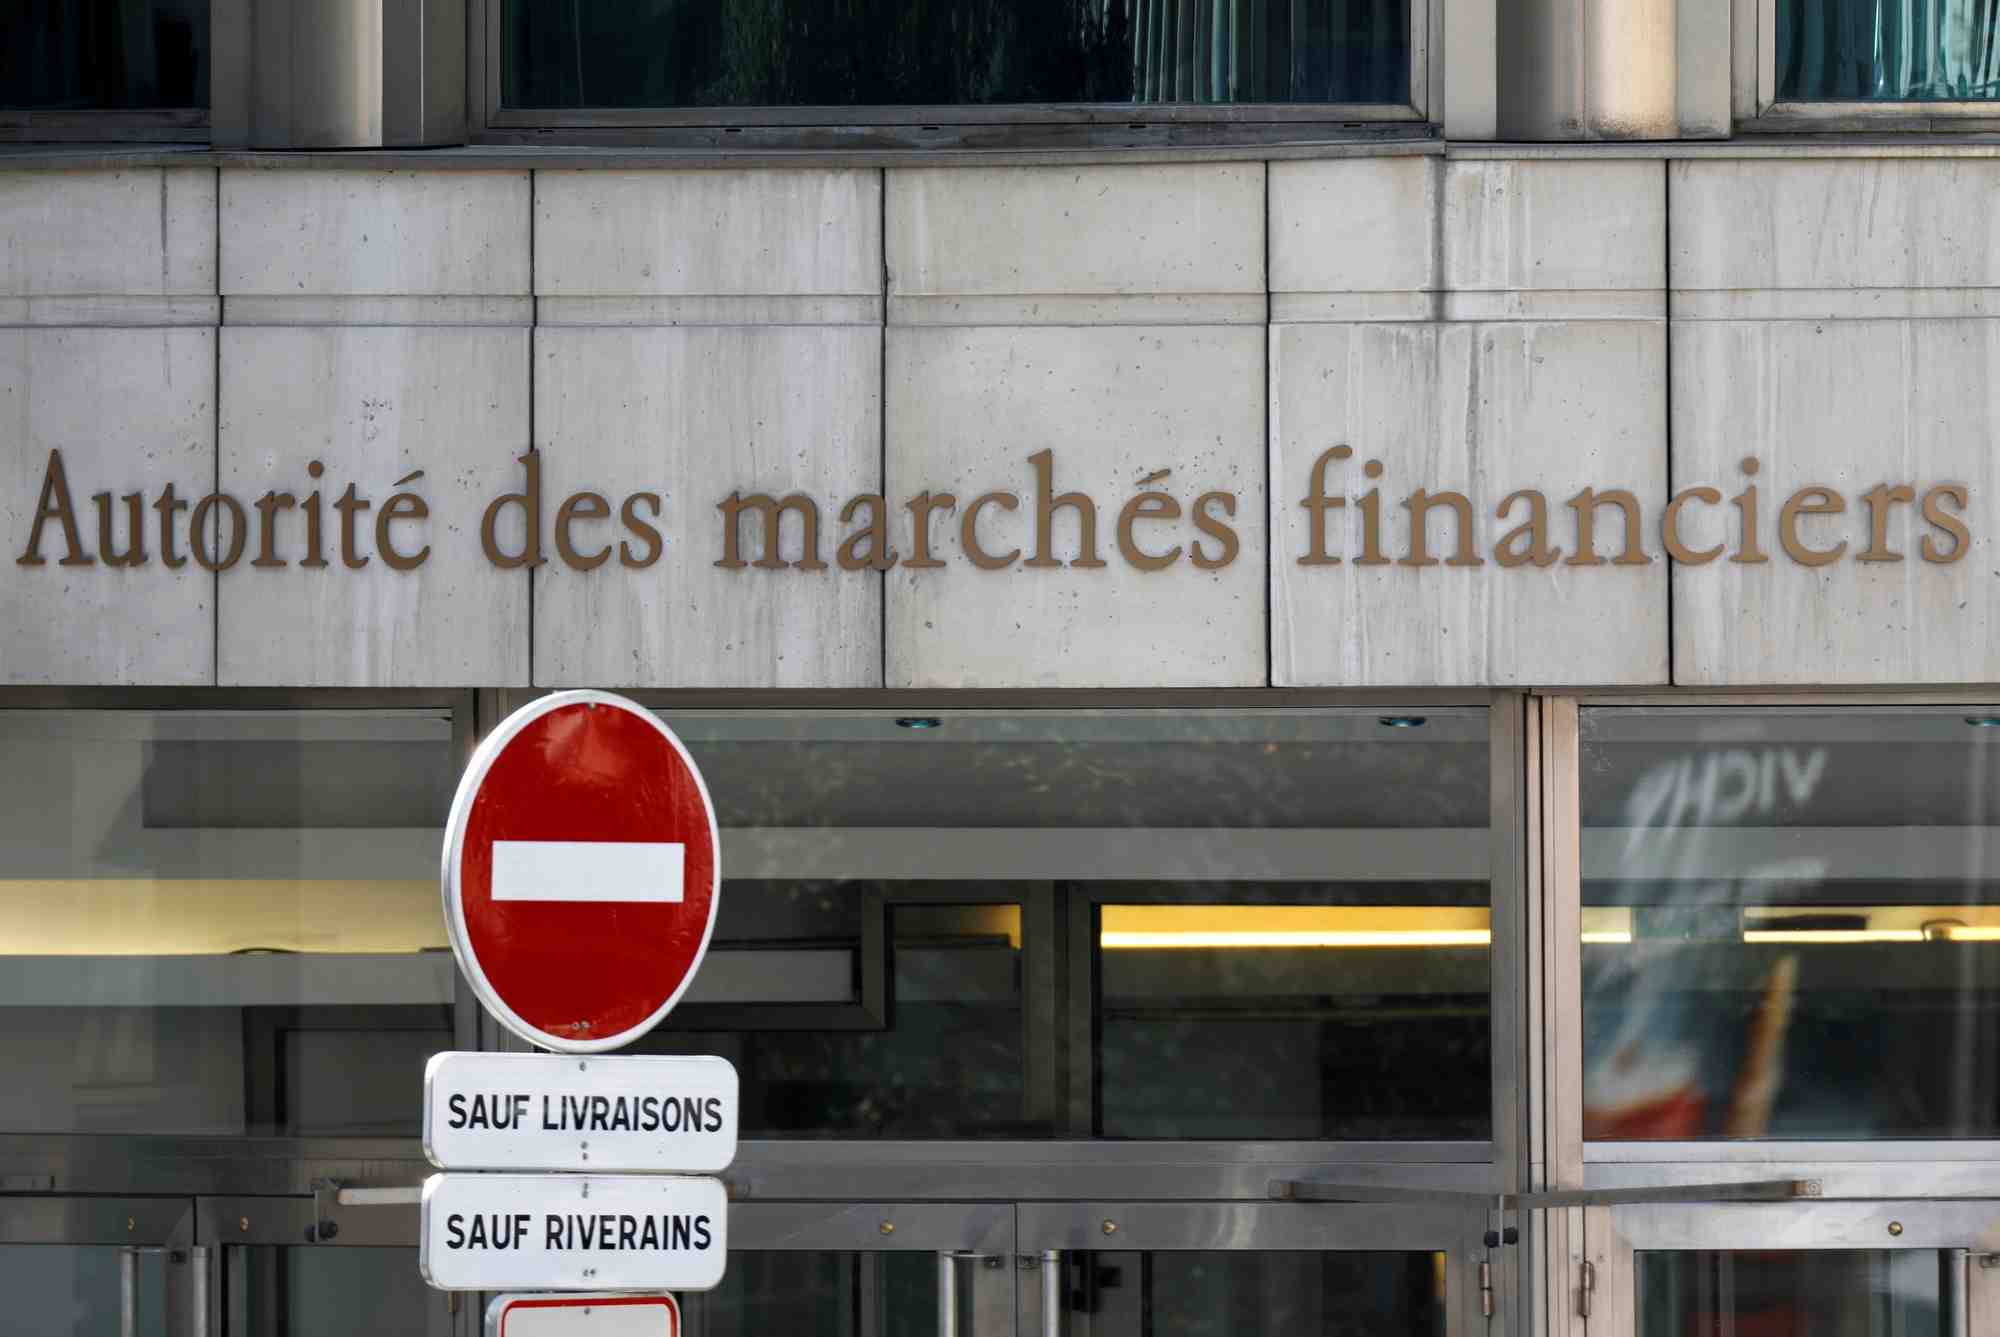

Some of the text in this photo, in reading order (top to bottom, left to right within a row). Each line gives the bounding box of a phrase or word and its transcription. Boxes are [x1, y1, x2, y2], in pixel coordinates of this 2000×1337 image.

[16, 444, 1971, 571] Autorité des marchés financiers
[448, 1094, 723, 1132] SAUF LIVRAISONS
[446, 1214, 712, 1251] SAUF RIVERAINS
